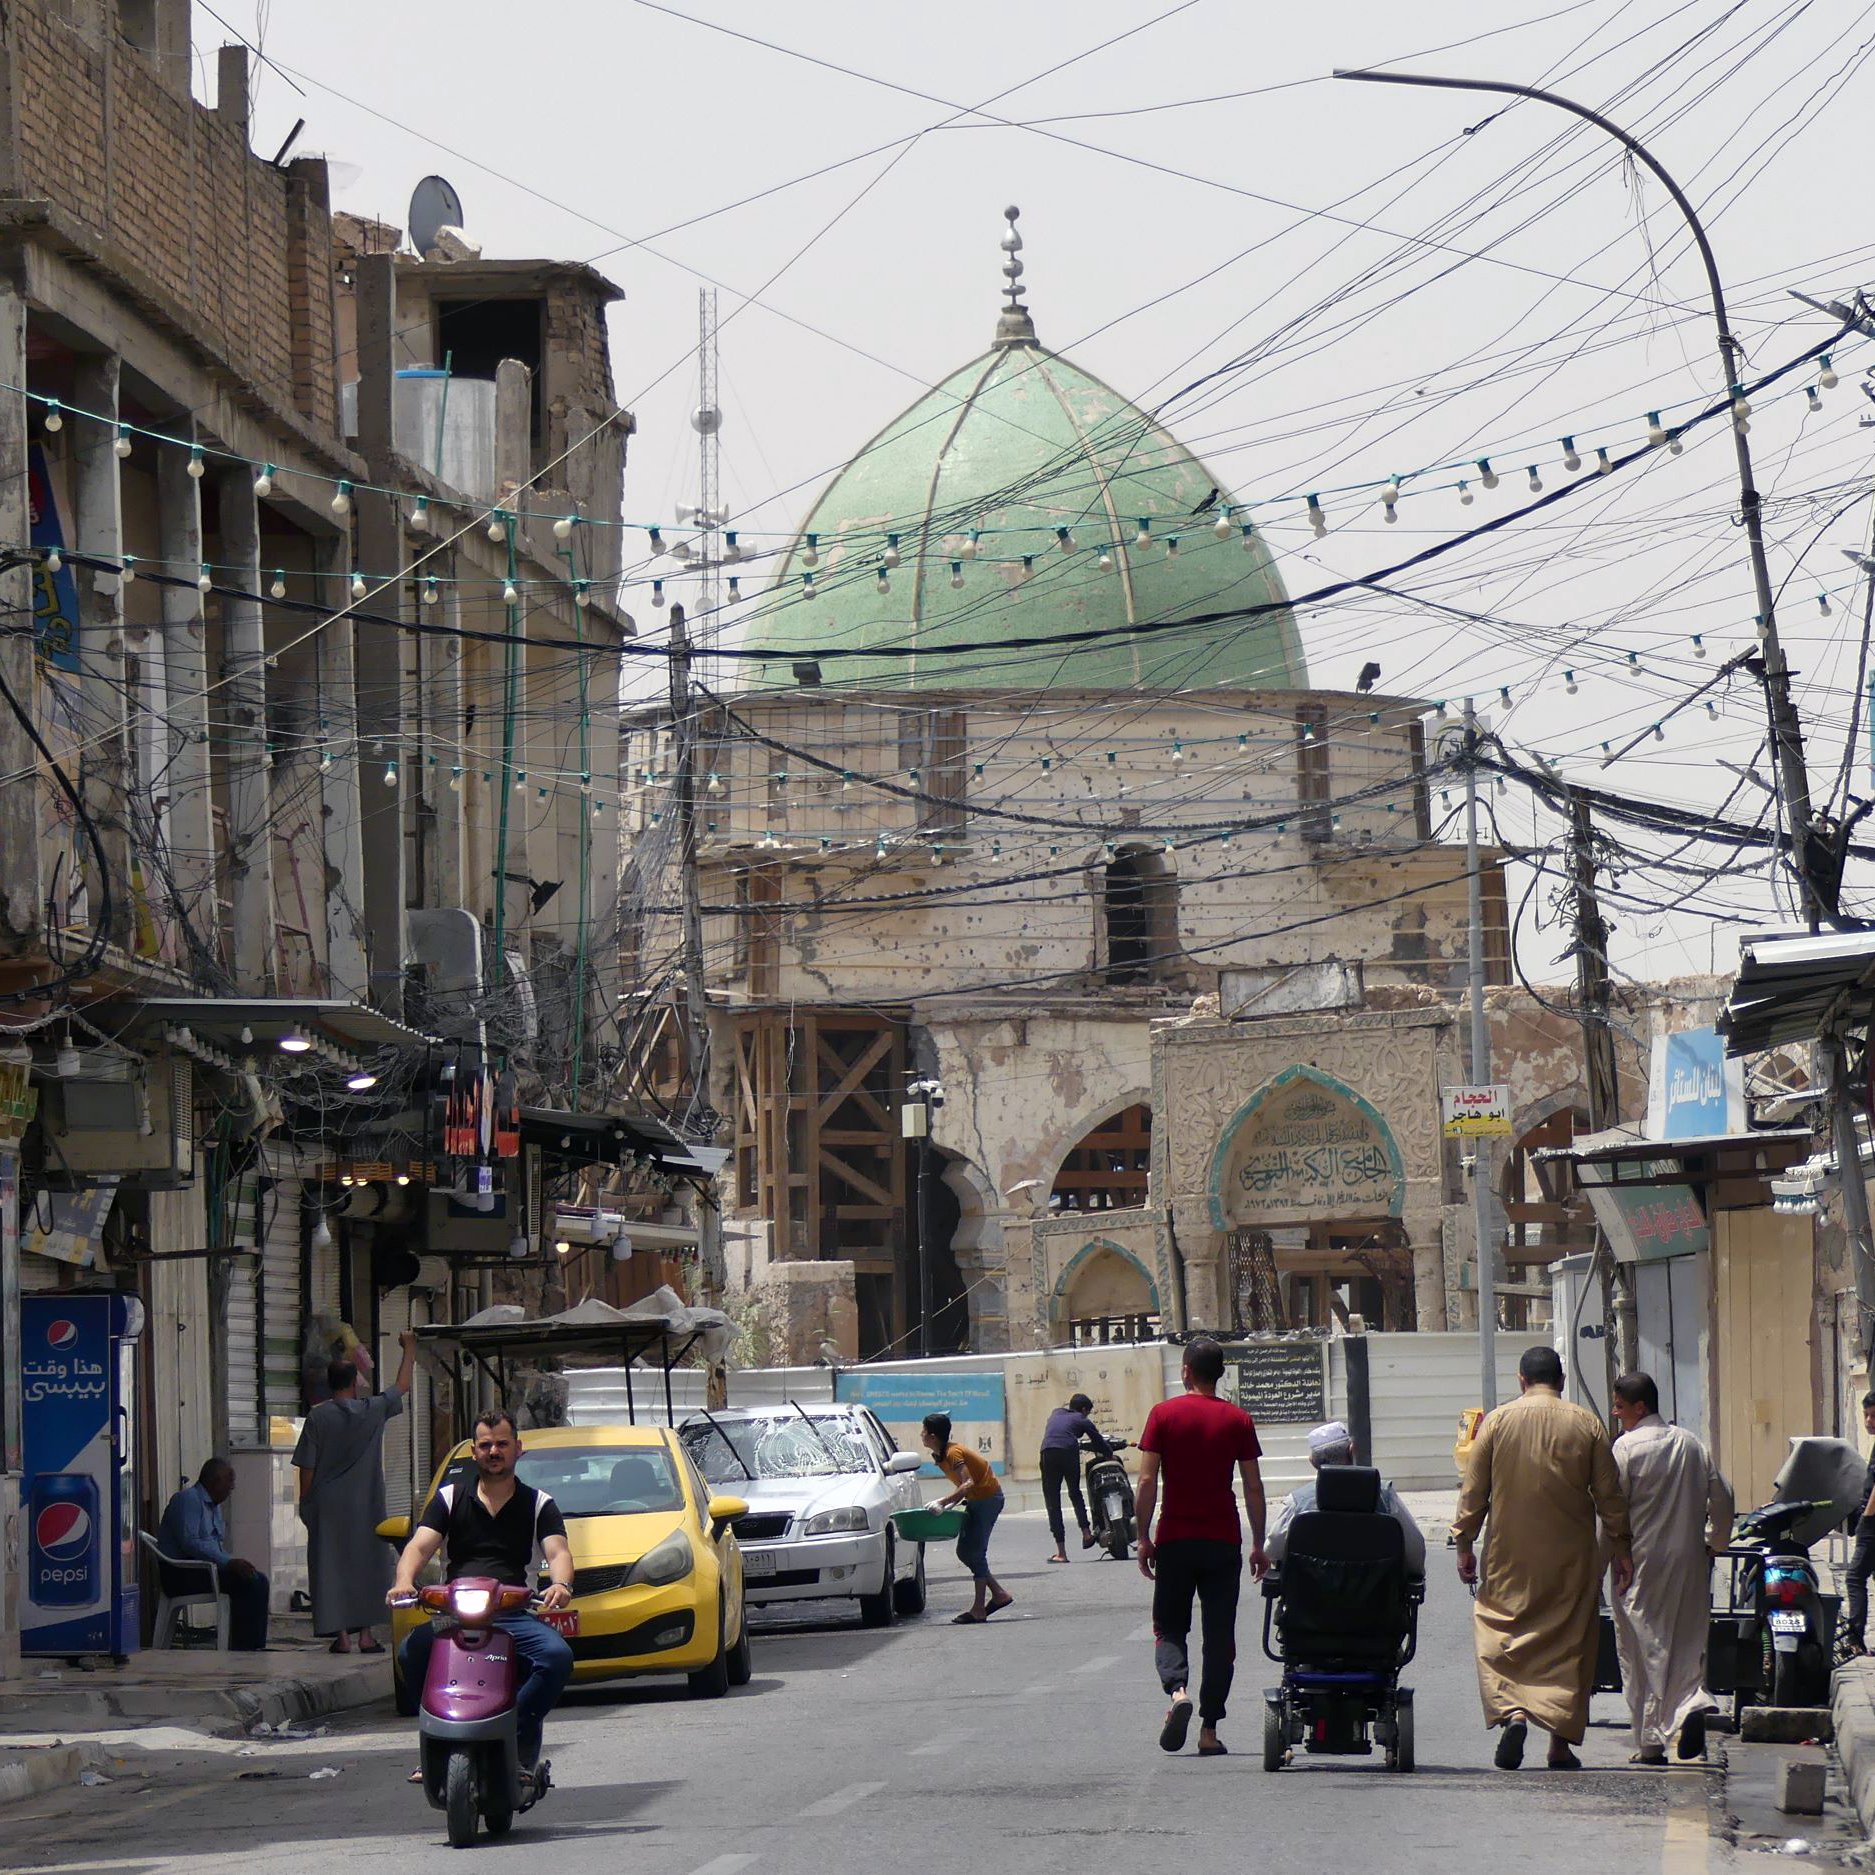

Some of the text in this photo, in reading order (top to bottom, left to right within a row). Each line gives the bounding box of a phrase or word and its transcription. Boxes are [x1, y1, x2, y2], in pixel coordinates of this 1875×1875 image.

[1453, 1088, 1498, 1109] الحجام
[1449, 1107, 1505, 1123] ابو هاجر
[22, 1358, 103, 1380] هذا وقت
[40, 1565, 88, 1585] pepsi
